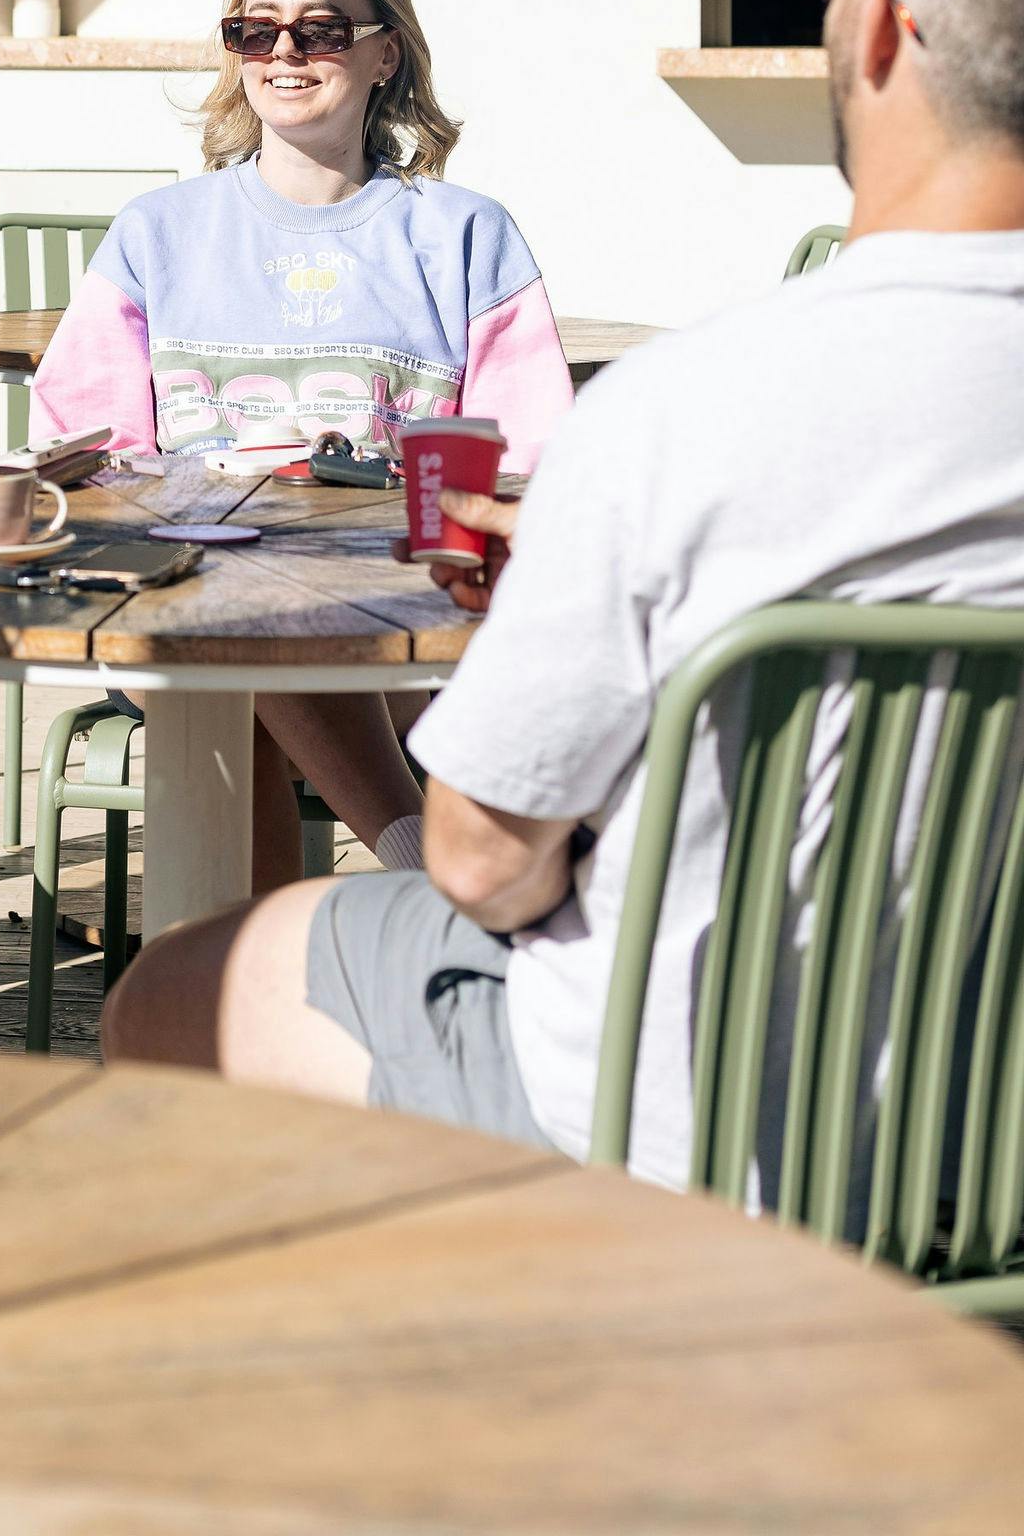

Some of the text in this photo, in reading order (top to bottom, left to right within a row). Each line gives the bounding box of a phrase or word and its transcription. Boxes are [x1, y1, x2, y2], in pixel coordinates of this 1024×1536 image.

[264, 251, 357, 275] SBO SKT
[166, 340, 184, 349] SBO
[186, 342, 203, 351] SKT
[205, 344, 239, 354] SPORTS
[241, 346, 264, 355] CLUB
[294, 347, 311, 356] SKT
[313, 345, 348, 354] SPORTS
[349, 345, 373, 355] CLUB
[416, 361, 449, 377] SPORTS
[188, 395, 206, 404] SBO
[226, 401, 261, 413] SPORTS
[263, 405, 285, 413] CLUB
[313, 403, 331, 411] SKT
[334, 403, 369, 412] SPORTS
[386, 413, 401, 423] SBO
[417, 452, 444, 540] ROSA'S
